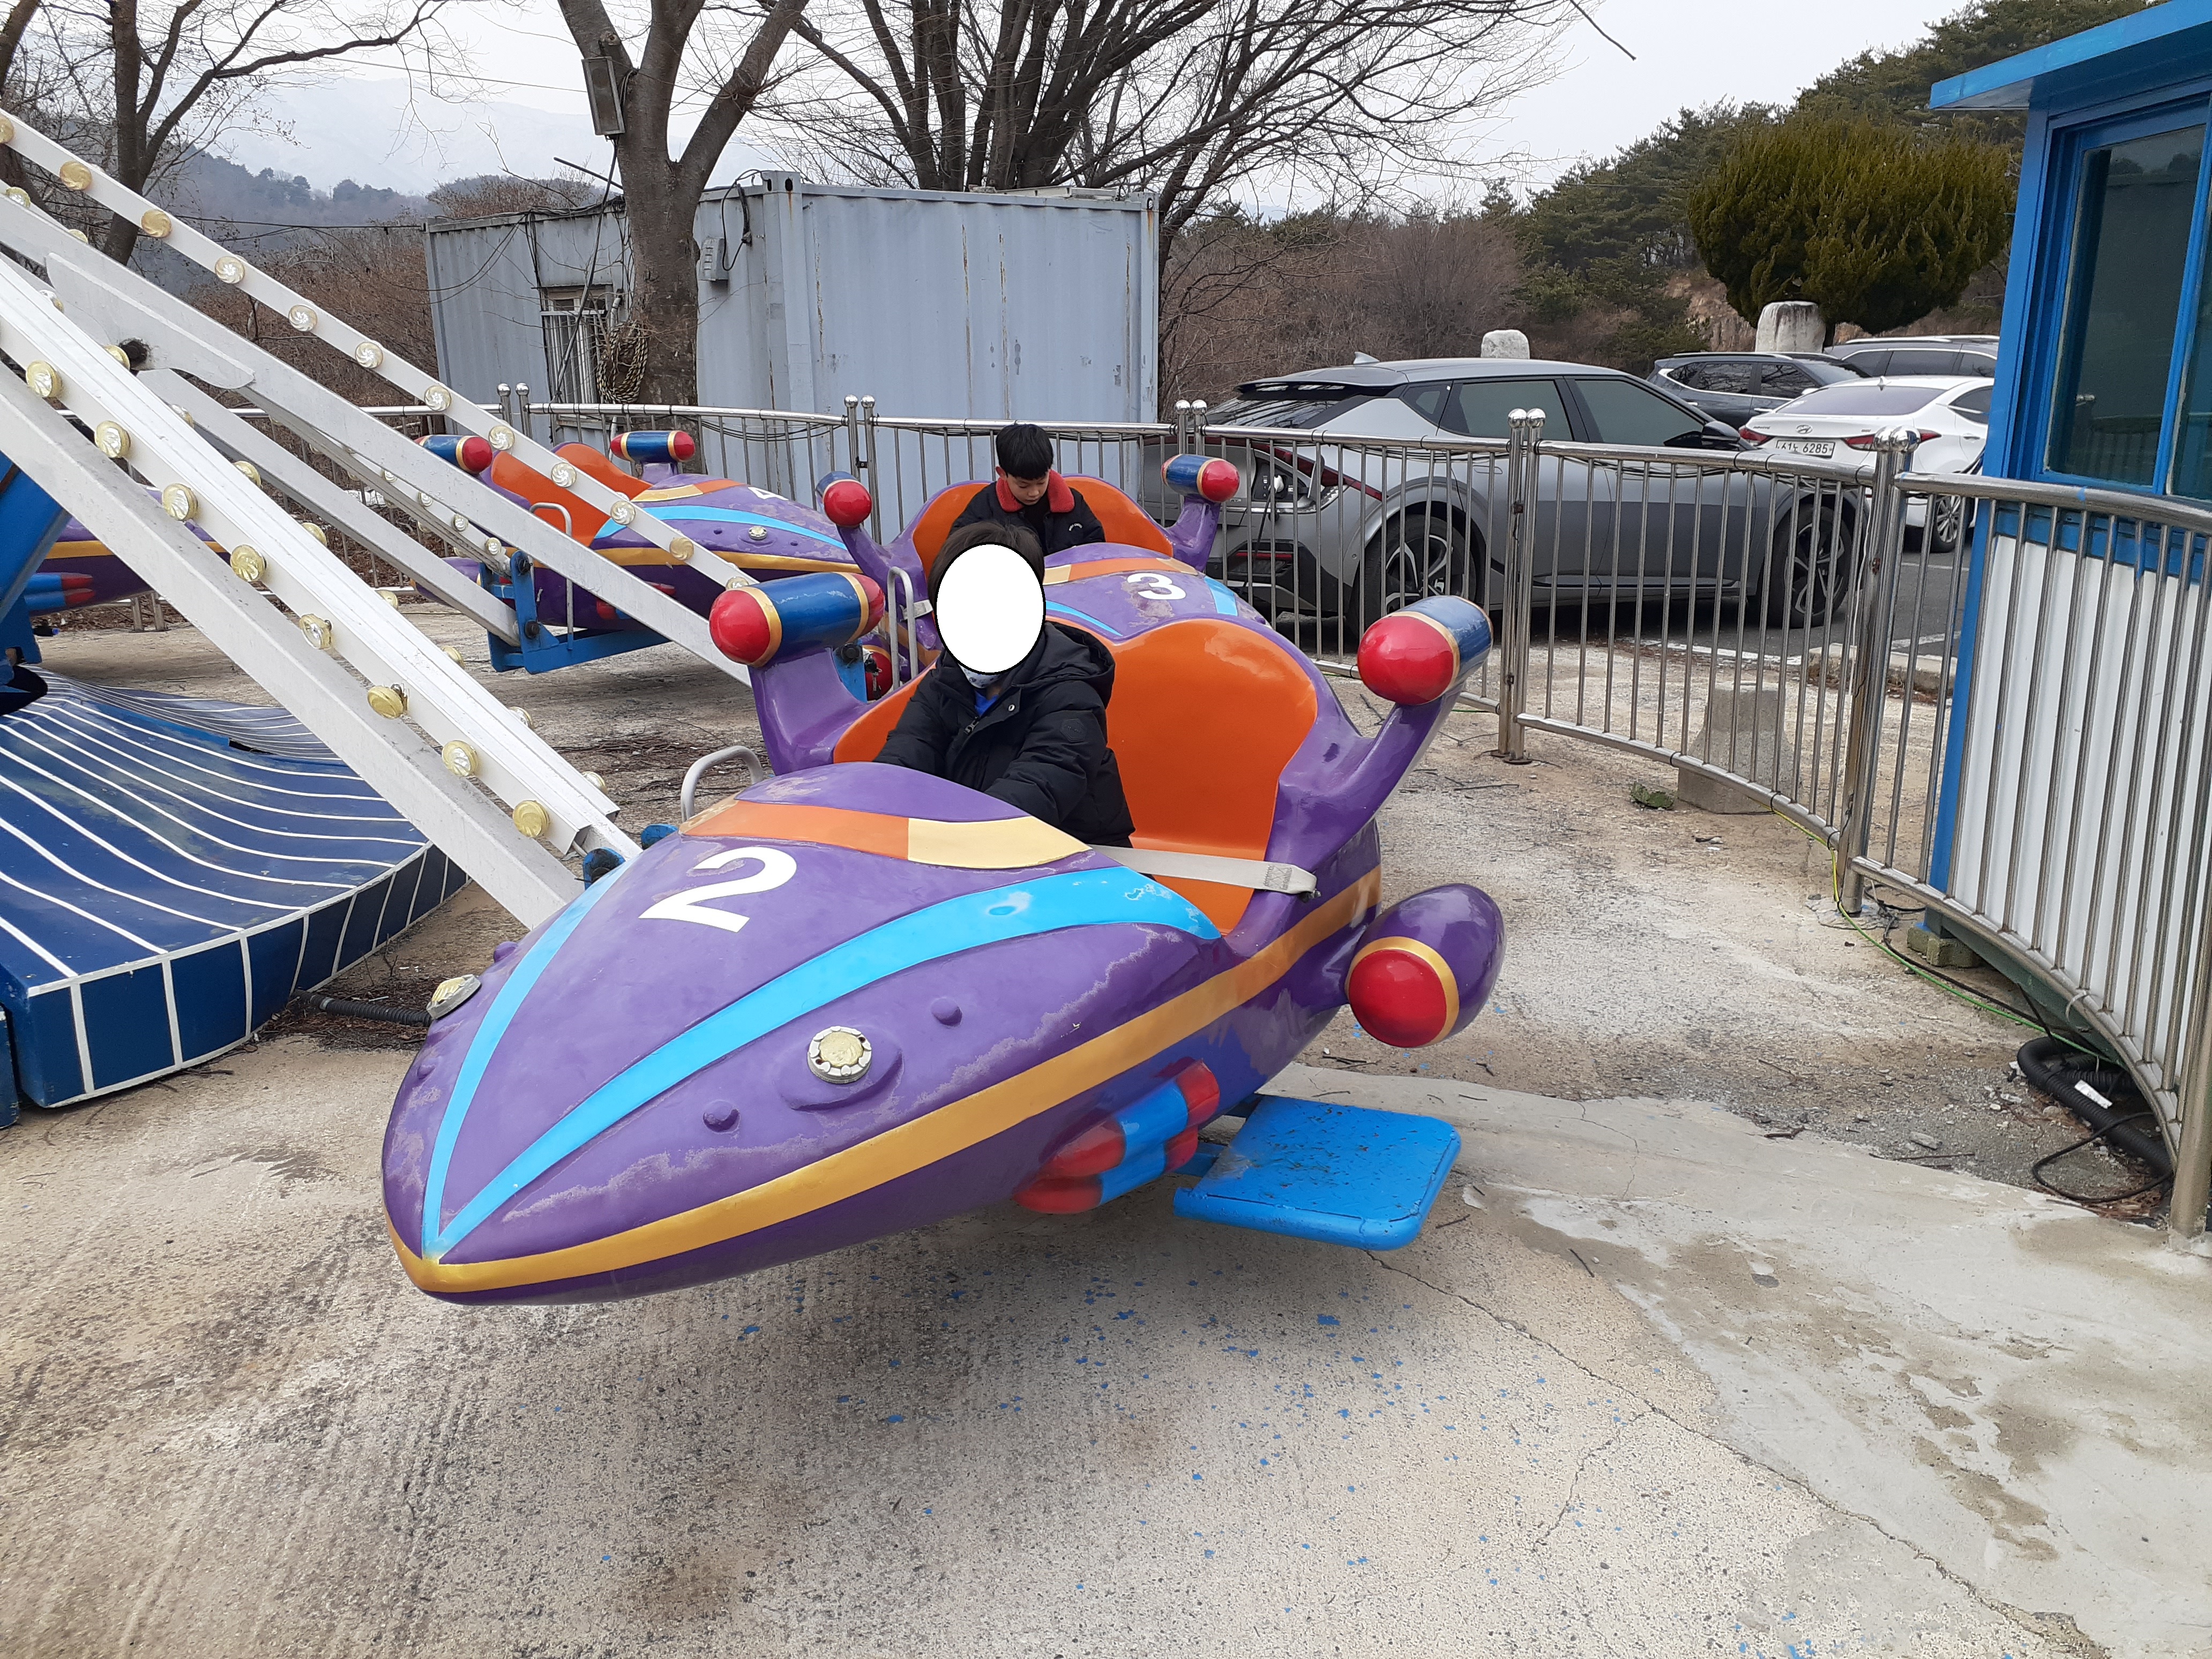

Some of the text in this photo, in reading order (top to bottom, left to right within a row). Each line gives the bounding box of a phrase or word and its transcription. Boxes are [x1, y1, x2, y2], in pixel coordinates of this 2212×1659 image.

[1803, 443, 1828, 454] 6285
[1127, 573, 1186, 600] 3
[638, 847, 797, 933] 2
